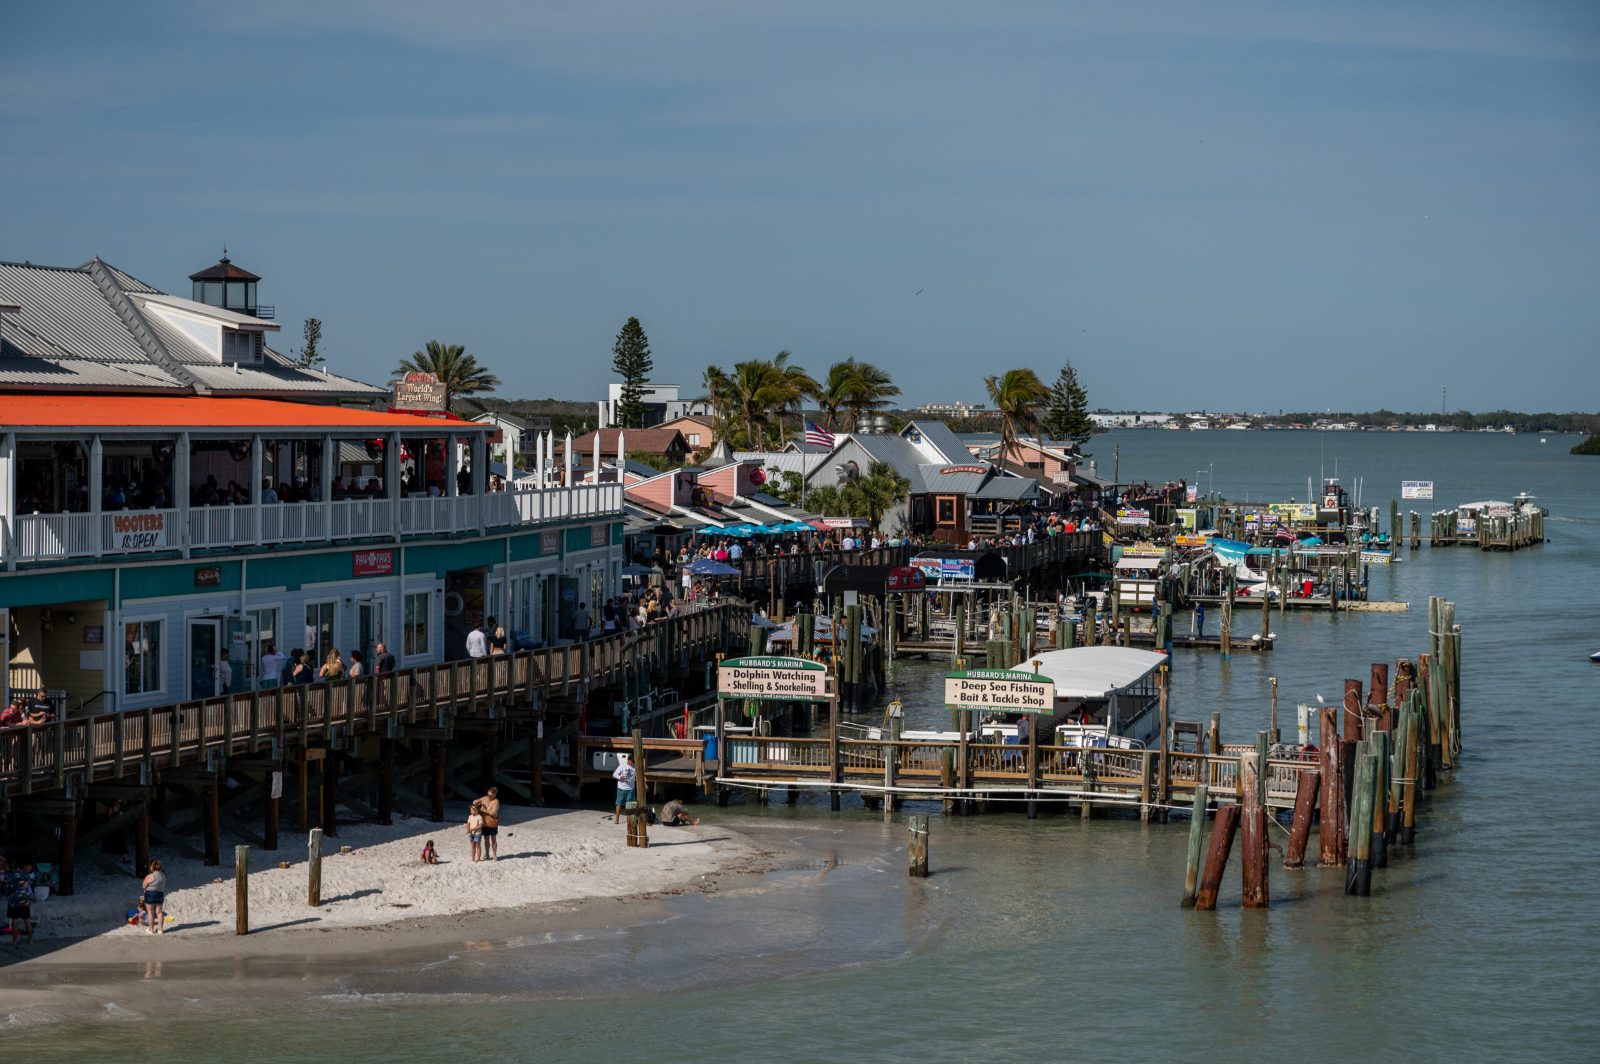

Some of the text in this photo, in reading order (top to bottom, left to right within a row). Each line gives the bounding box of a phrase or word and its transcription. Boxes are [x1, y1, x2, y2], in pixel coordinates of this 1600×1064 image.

[407, 383, 434, 393] World's
[397, 392, 442, 404] Largest Wing!
[114, 513, 164, 533] HOOTERS
[122, 532, 158, 549] IS OPEN
[739, 660, 776, 668] HUBBARD'S
[733, 670, 816, 683] Dolphin Watching
[967, 671, 1032, 681] HUBBARD'S MARINA
[733, 681, 816, 694] Shelling & Snorkeling
[961, 681, 1045, 696] Deep Sea Fishing
[960, 692, 1045, 707] Bait & Tackle Shop
